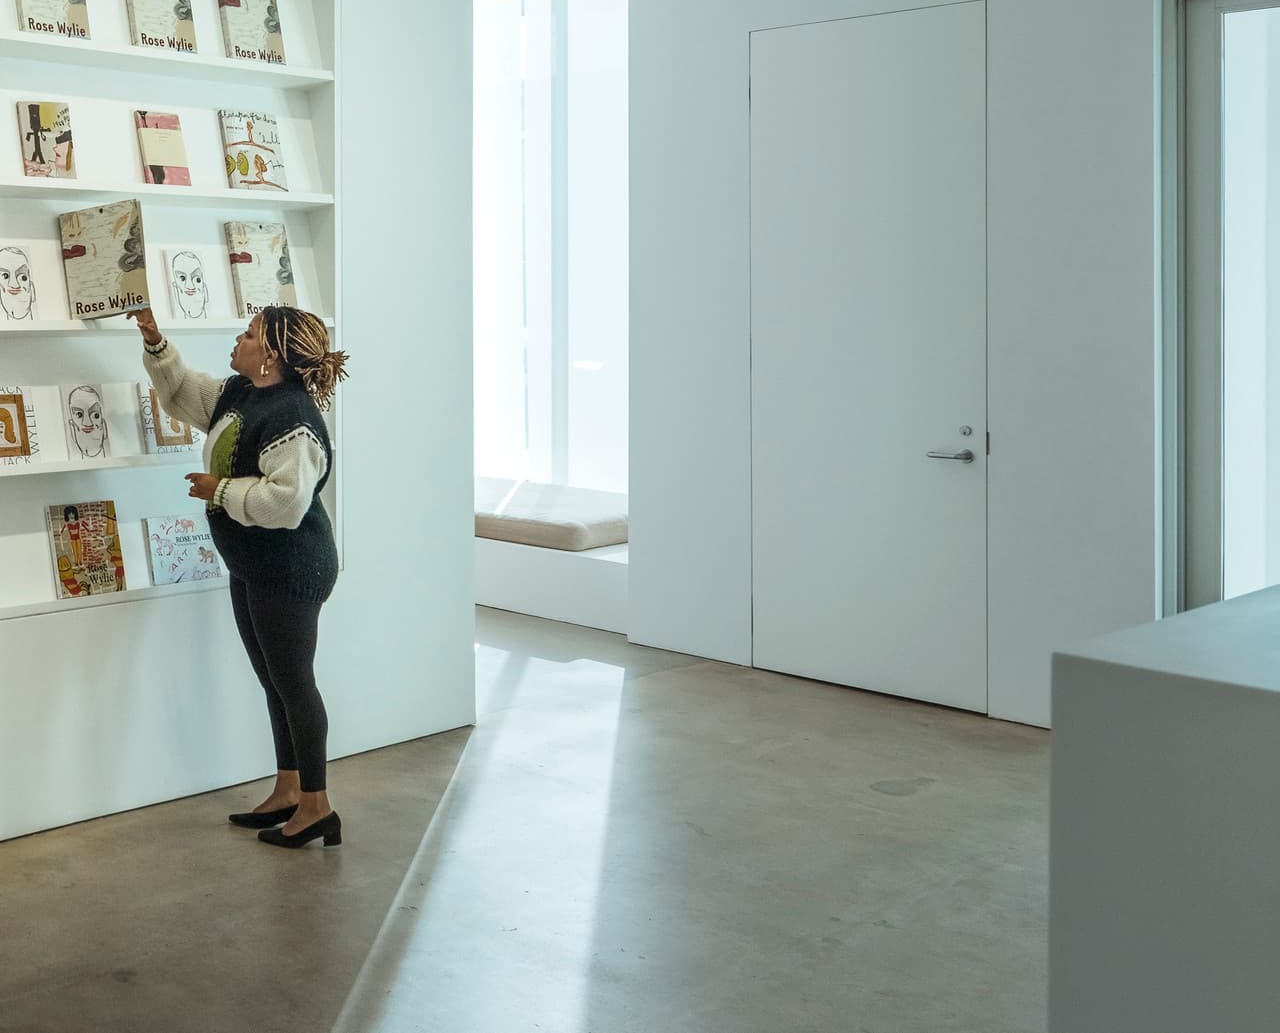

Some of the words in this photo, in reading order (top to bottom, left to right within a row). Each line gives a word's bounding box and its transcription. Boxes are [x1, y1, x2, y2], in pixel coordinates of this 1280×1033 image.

[28, 17, 55, 33] Rose
[56, 21, 86, 38] Wylie
[141, 32, 165, 47] Rose
[167, 36, 193, 52] Wylie
[234, 45, 257, 59] Rose
[258, 48, 283, 64] Wylie
[75, 300, 106, 315] Rose
[108, 292, 144, 311] Wylie
[246, 302, 265, 315] Ros
[141, 395, 155, 435] ROSE
[25, 404, 41, 456] WYLIE
[175, 534, 192, 543] ROSE
[192, 532, 211, 541] WYLIE
[87, 563, 108, 574] Rose
[89, 573, 115, 585] Wylie
